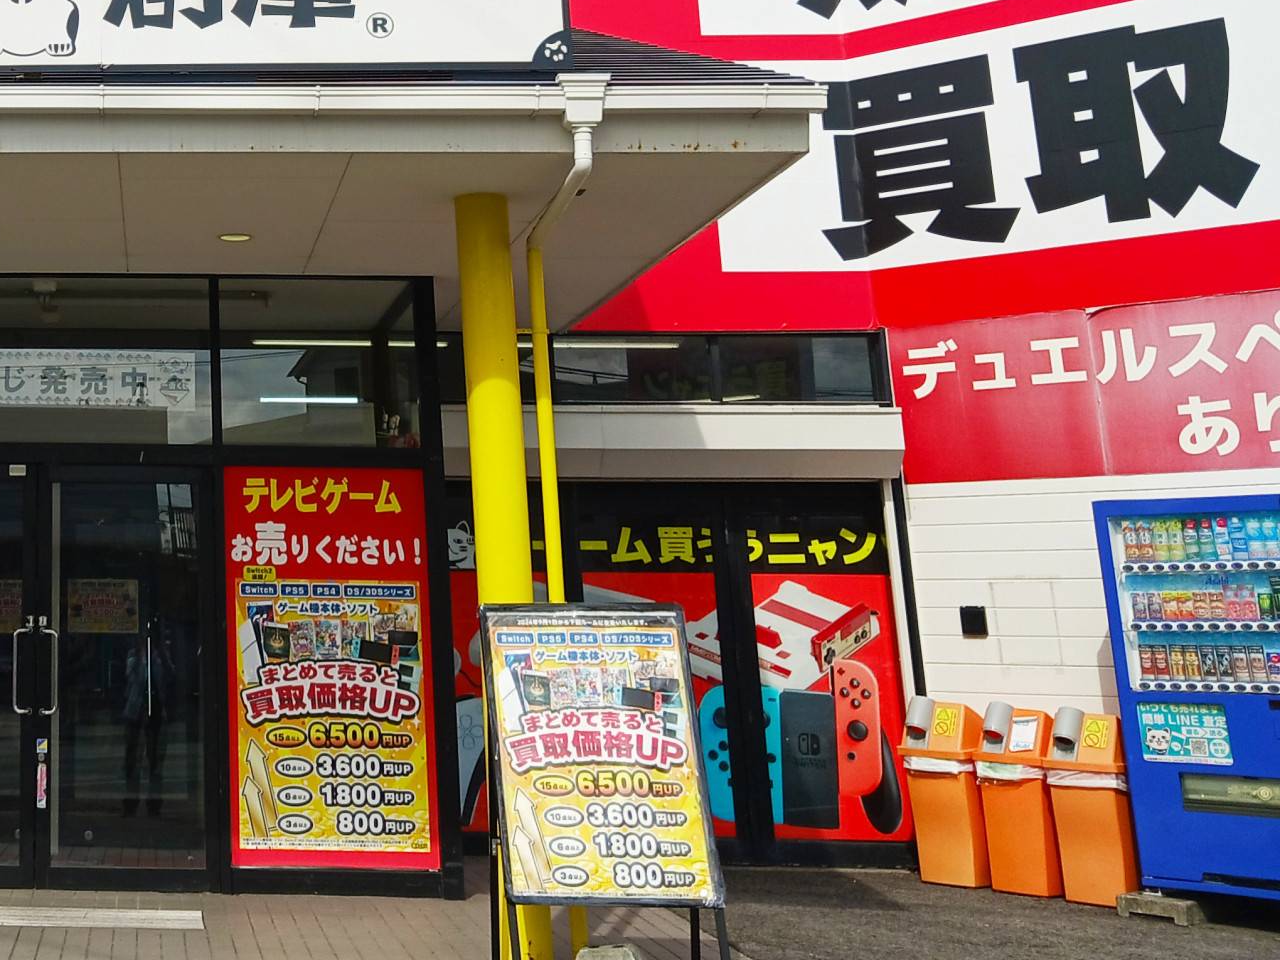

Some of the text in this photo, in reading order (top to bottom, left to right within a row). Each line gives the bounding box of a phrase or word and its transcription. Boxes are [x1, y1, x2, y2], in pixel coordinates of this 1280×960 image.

[821, 17, 1261, 262] 買取
[242, 477, 402, 514] テレビゲーム
[532, 526, 877, 565] ーム買うニャン
[245, 585, 412, 597] Switch PS5 PS4 DS/3DSシリーズ
[541, 634, 562, 643] PS5
[573, 634, 594, 643] PS4
[261, 663, 399, 687] まとめて売ると
[245, 682, 417, 720] 買取価格UP
[523, 711, 664, 734] まとめて売ると
[1167, 714, 1200, 726] LINE
[508, 730, 684, 767] 買取価格UP
